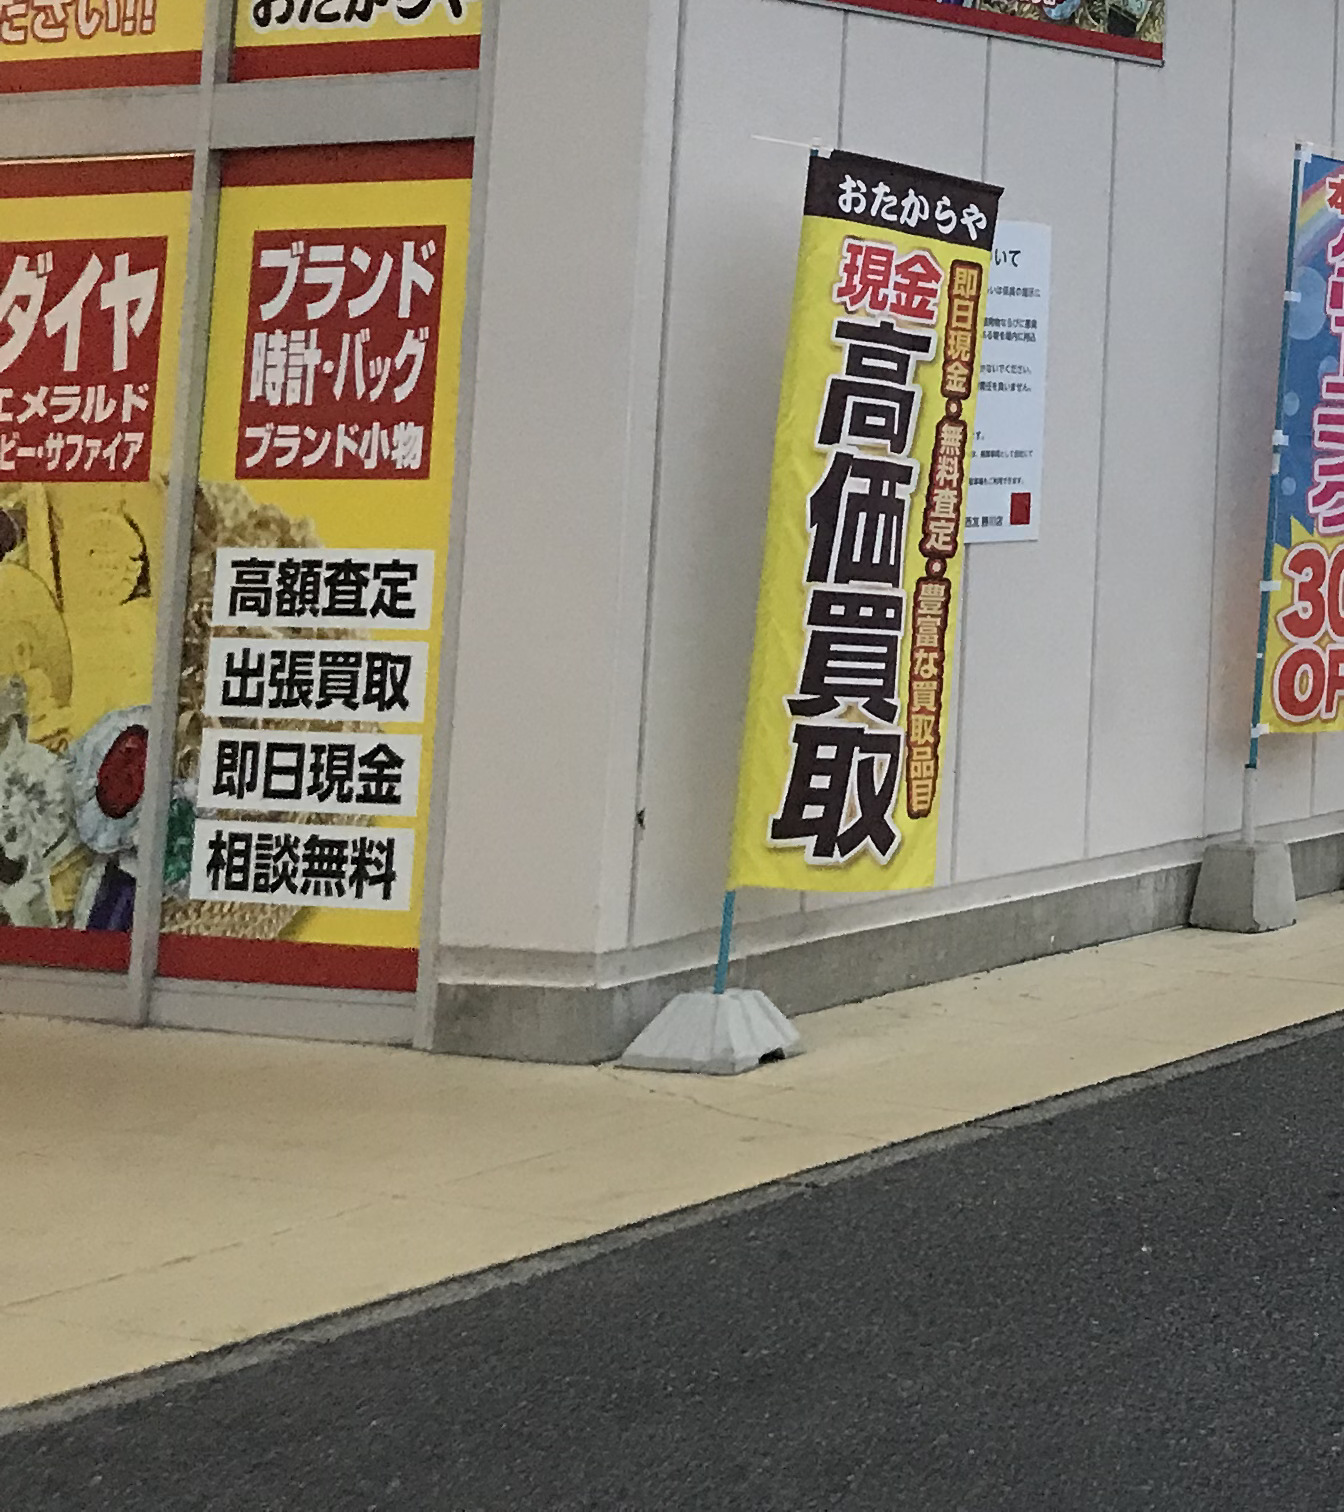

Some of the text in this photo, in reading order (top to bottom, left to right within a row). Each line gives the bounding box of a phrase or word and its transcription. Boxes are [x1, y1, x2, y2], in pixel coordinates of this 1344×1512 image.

[838, 175, 987, 240] おたからや
[259, 240, 435, 321] ブランド
[837, 243, 942, 320] 現金
[990, 248, 1022, 268] いて
[0, 251, 158, 373] ダイヤ
[249, 327, 429, 406] 時計・バッグ
[245, 422, 424, 471] ブランド小物
[228, 557, 418, 619] 高額査定
[770, 320, 932, 859] 高価買取
[221, 648, 412, 712] 出張買取
[212, 740, 406, 805] 即日現金
[206, 830, 398, 901] 相談無料
